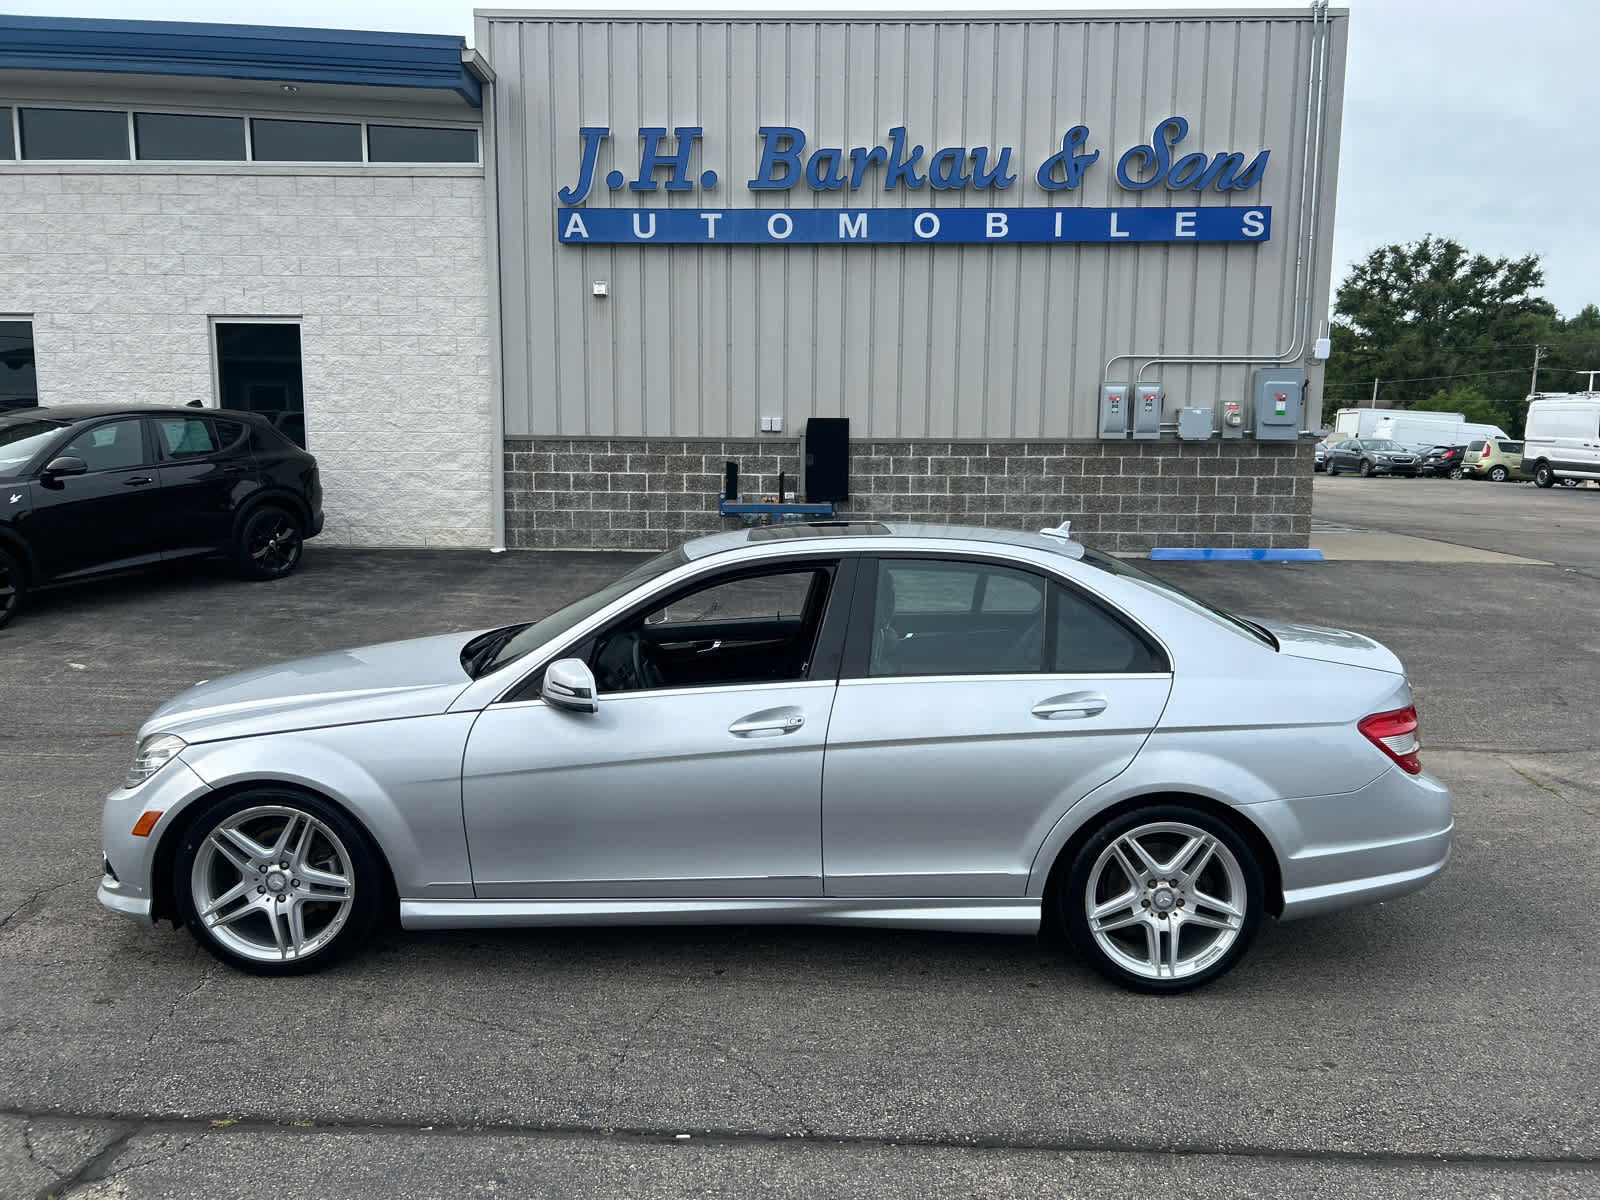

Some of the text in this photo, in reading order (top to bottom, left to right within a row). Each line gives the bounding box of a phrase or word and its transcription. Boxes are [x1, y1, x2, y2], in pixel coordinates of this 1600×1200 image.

[558, 116, 1271, 205] J.H. Barkau & Sons
[564, 211, 1265, 239] AUTOMOBILES
